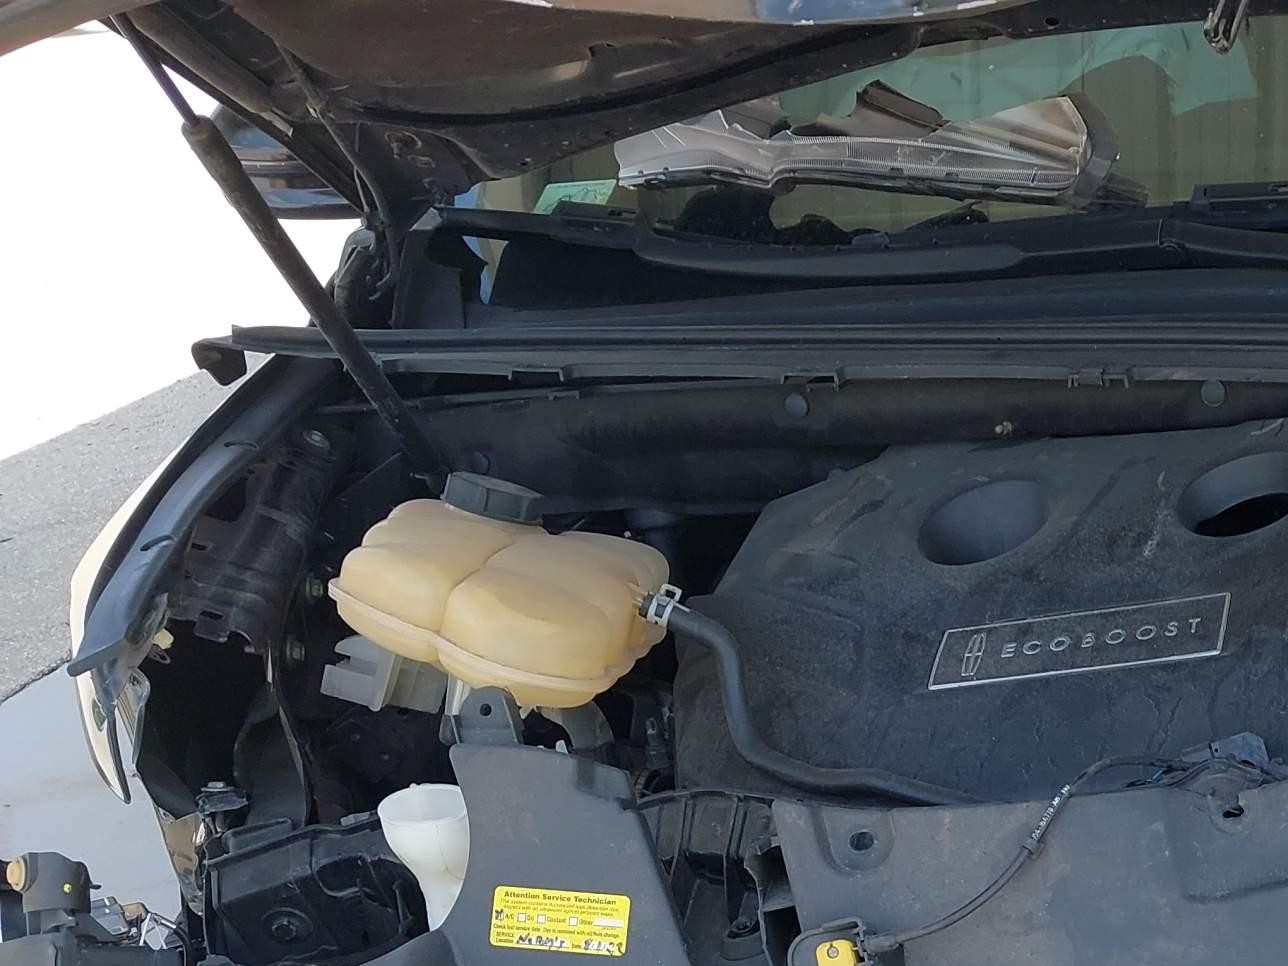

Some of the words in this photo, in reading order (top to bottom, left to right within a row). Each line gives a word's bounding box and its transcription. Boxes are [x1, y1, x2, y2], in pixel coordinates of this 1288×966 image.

[1000, 617, 1202, 658] ECOBOOST
[504, 890, 539, 899] Attention
[542, 893, 570, 902] Service
[574, 896, 616, 905] Technician
